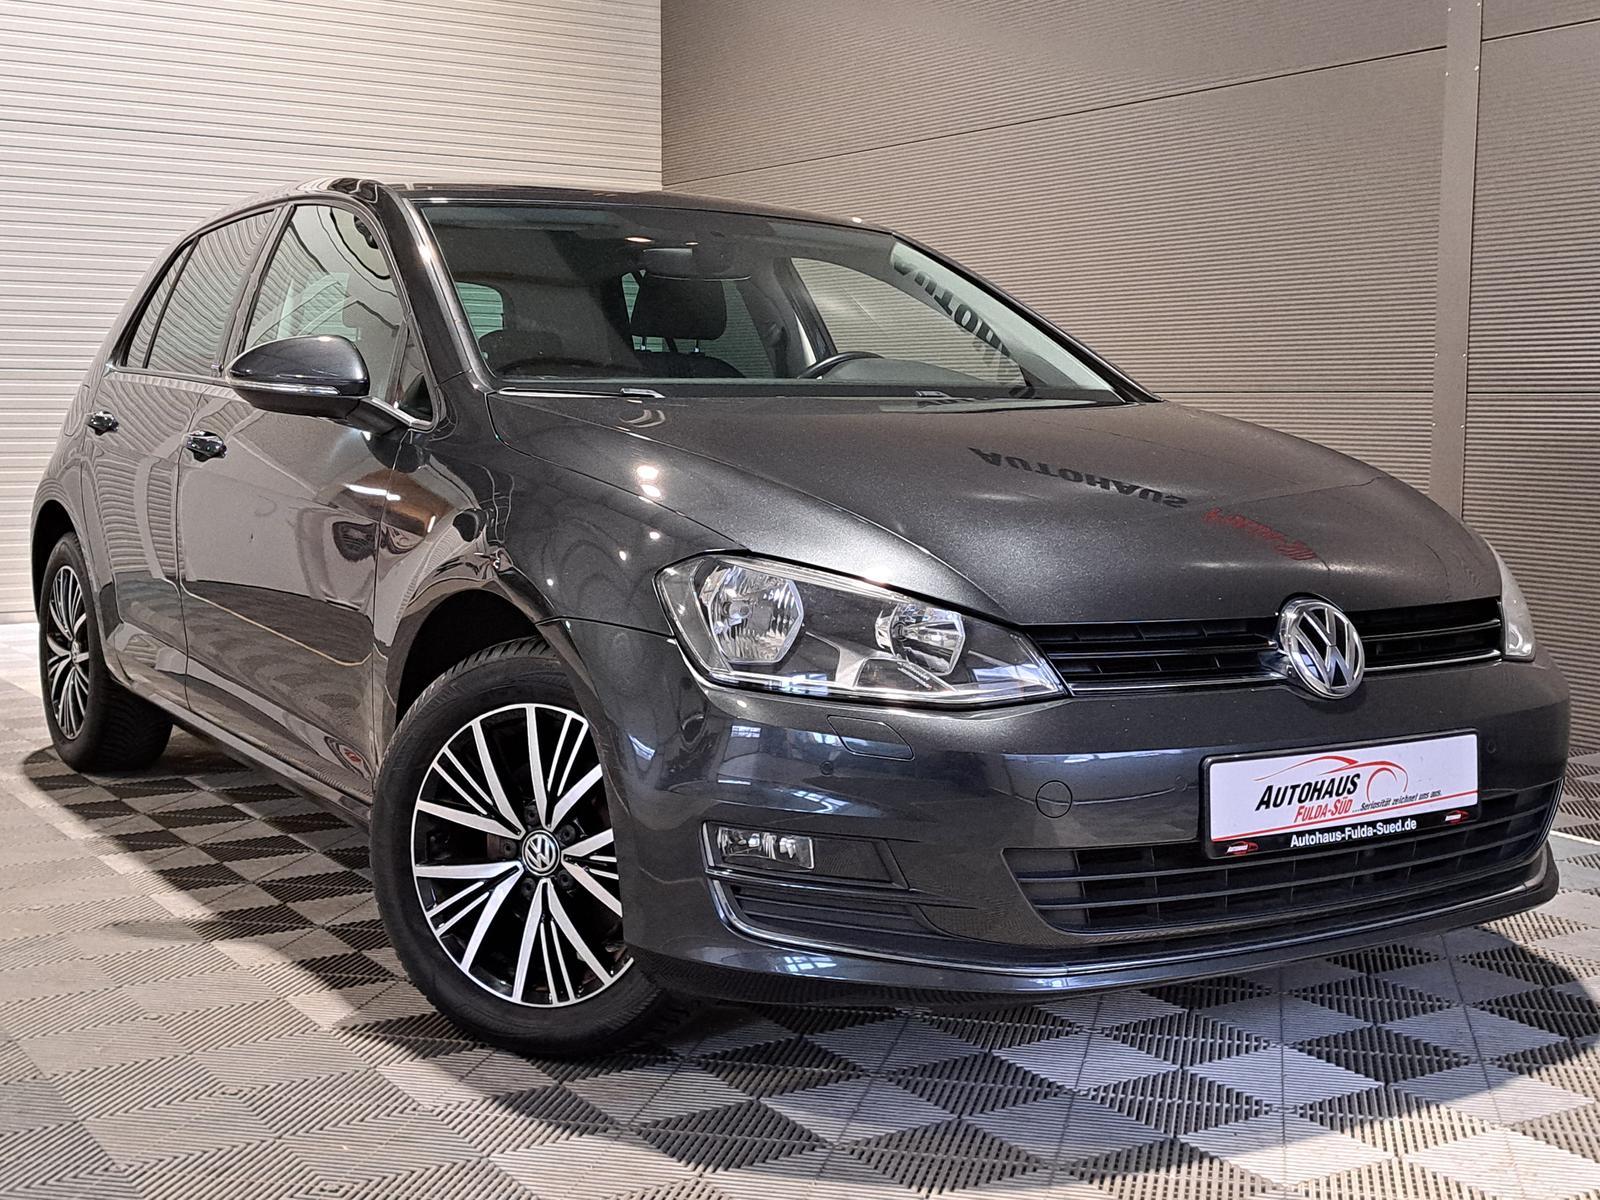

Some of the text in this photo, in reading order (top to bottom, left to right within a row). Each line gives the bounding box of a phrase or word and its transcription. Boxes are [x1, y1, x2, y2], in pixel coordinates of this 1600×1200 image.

[1283, 601, 1363, 698] VW
[1255, 773, 1360, 811] AUTOHAUS
[1294, 796, 1353, 823] FULDA-SÜD
[1290, 818, 1417, 847] Autohaus-Fulda-Sued.de
[523, 832, 558, 874] VW
